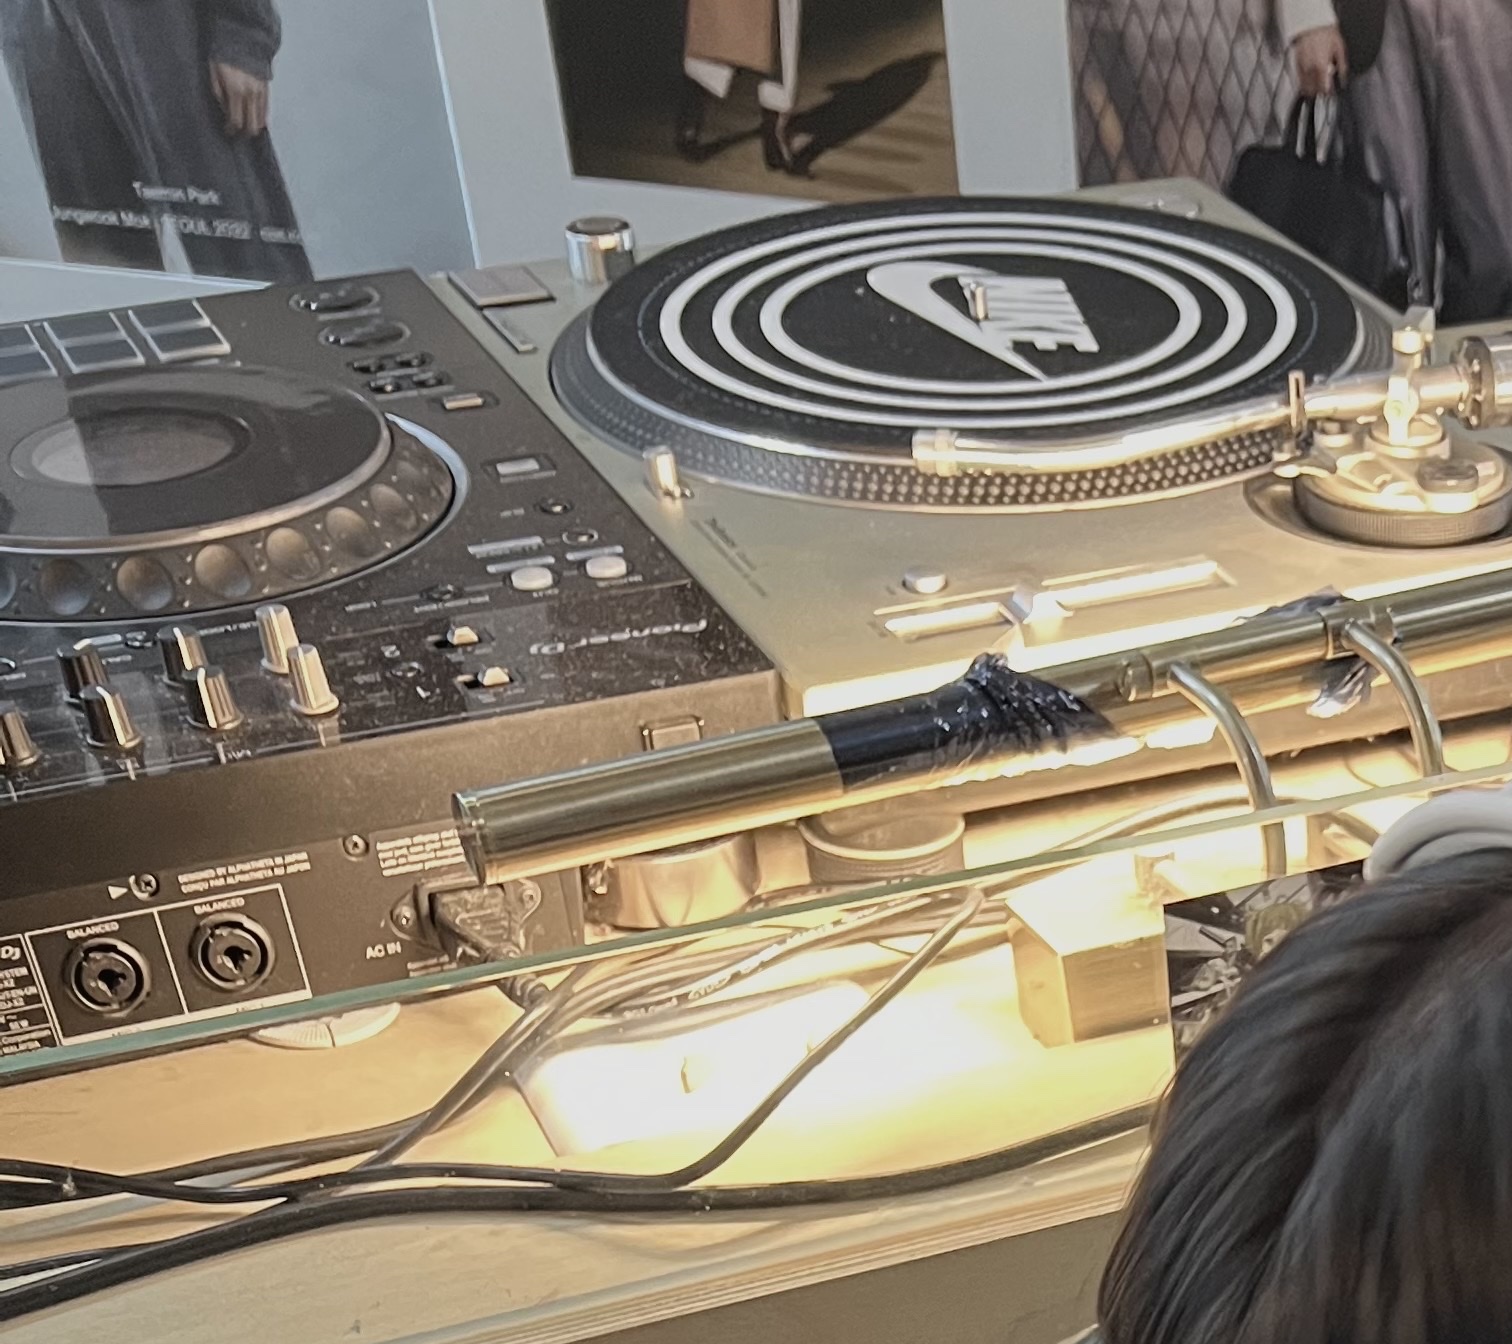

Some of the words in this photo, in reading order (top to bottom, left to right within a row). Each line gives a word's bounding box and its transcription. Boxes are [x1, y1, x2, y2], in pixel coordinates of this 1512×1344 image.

[957, 275, 1100, 353] NIKE
[194, 897, 245, 916] BALANCED
[66, 921, 119, 940] BALANCED
[366, 945, 386, 961] AC
